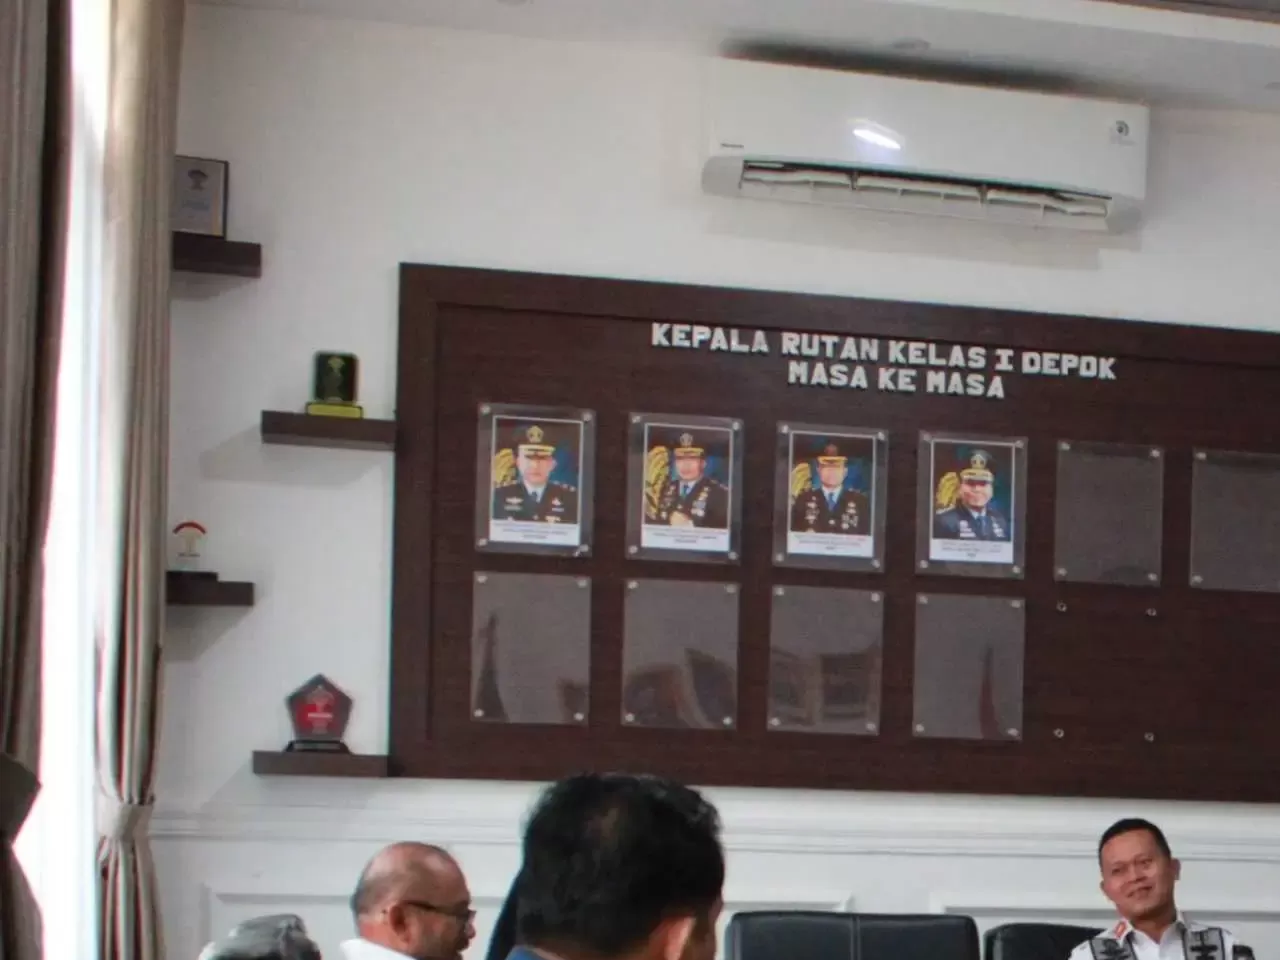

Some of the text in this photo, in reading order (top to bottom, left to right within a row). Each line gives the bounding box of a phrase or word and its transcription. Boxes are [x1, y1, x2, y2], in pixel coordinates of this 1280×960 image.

[651, 322, 1117, 380] KEPALA RUTAN KELAS I DEPOK
[788, 360, 1005, 399] MASA KE MASA
